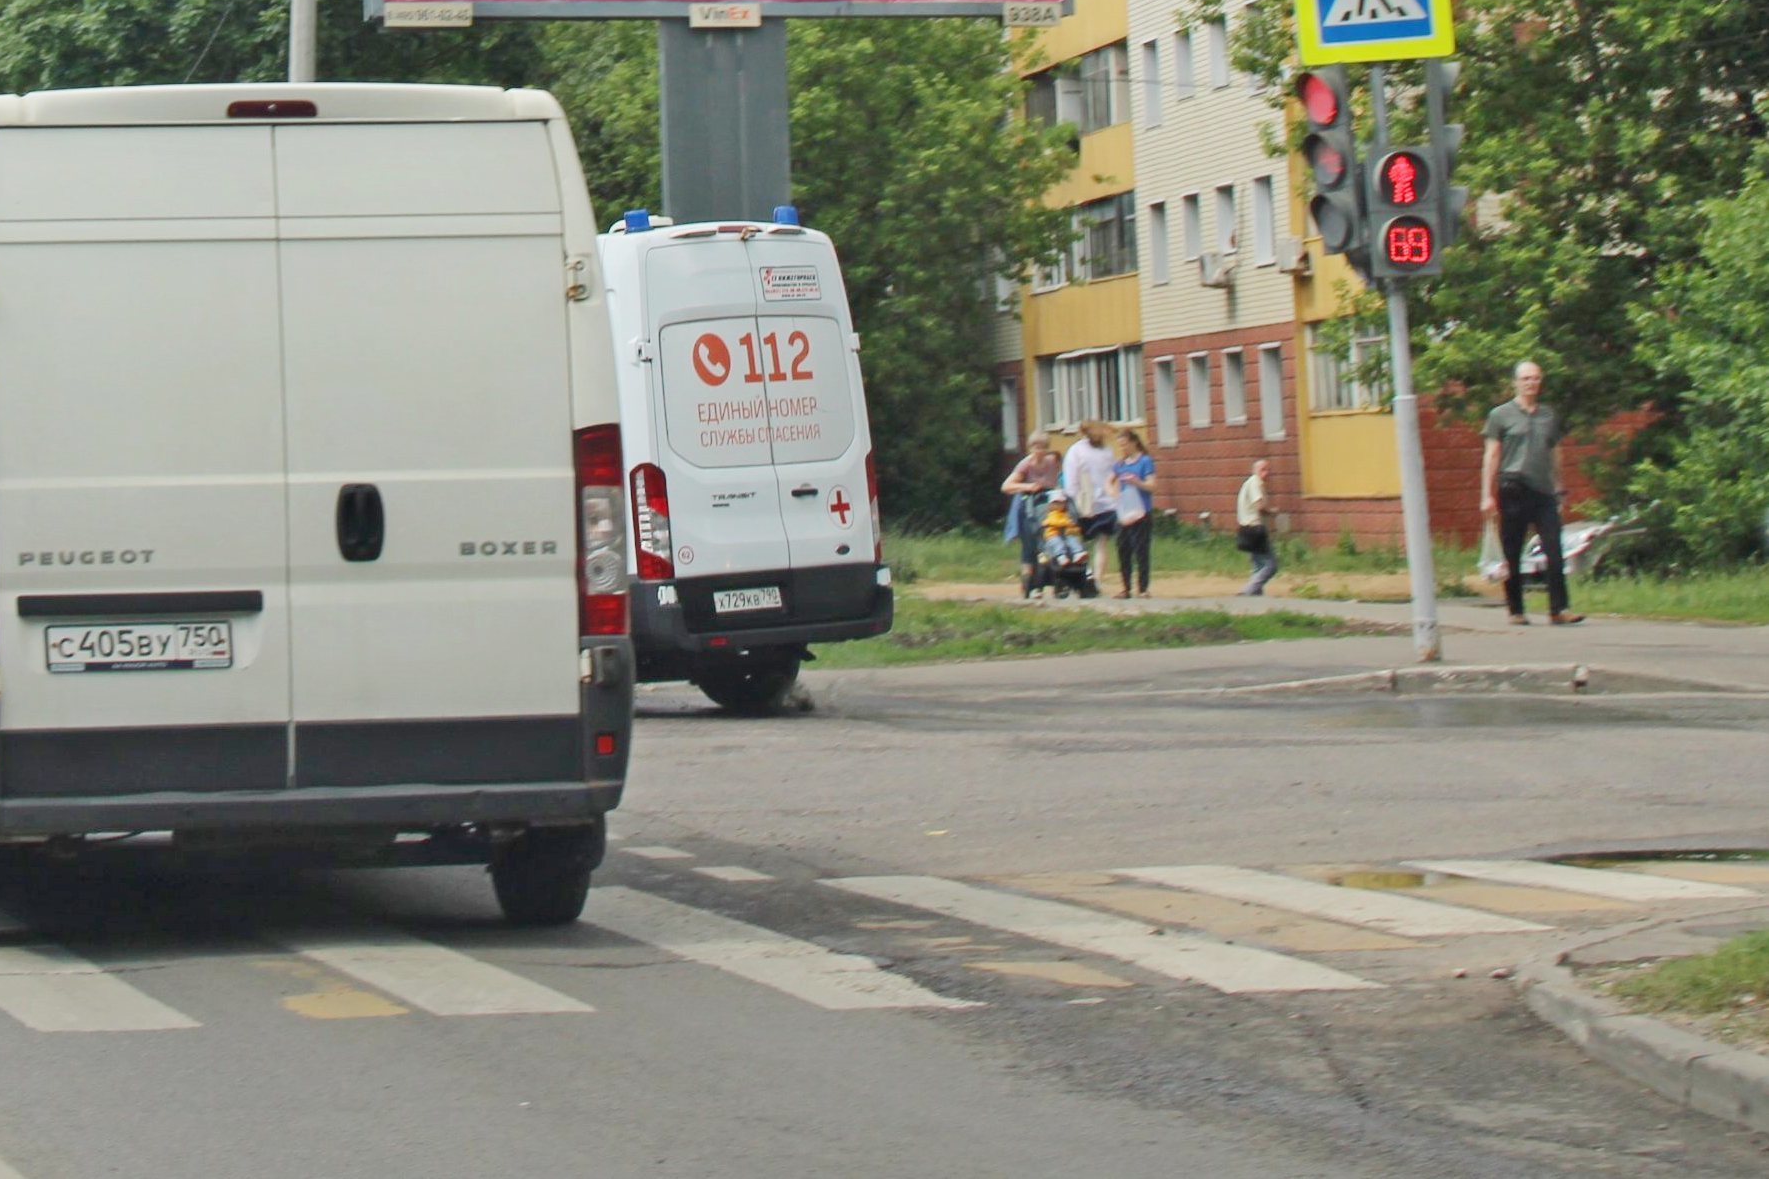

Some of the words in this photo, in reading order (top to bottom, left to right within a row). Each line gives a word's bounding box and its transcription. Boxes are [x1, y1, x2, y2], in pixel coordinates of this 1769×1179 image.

[738, 330, 814, 383] 112
[697, 394, 764, 425] ЕДИНЫЙ
[768, 396, 818, 418] НОМЕР
[700, 427, 756, 448] СЛУЖБЫ
[757, 423, 821, 443] СПАСЕНИЯ
[18, 549, 156, 566] PEUGEOT
[459, 540, 558, 556] BOXER
